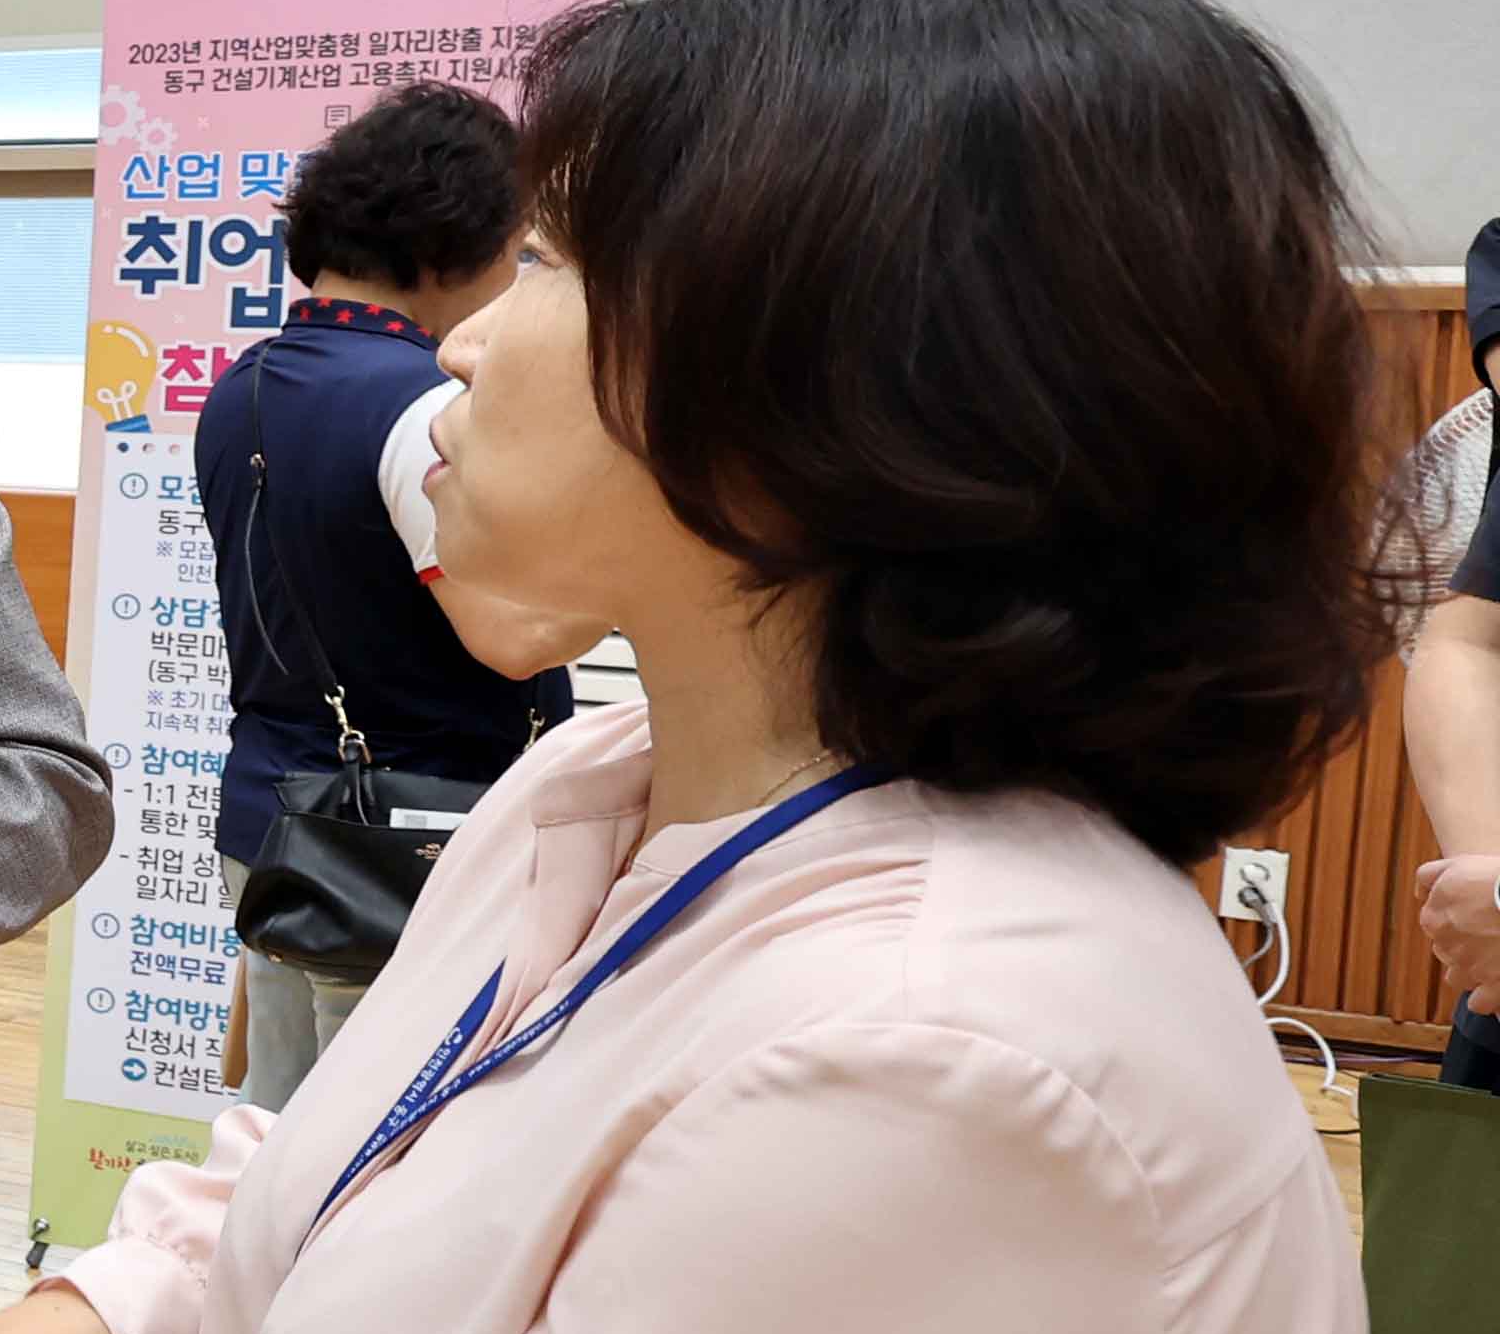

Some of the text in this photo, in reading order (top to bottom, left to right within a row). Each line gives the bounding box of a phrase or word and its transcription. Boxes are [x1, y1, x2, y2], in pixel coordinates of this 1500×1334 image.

[128, 39, 202, 66] 2023년
[207, 33, 361, 63] 지역산업맞춤형
[368, 27, 484, 57] 일자리창출
[163, 69, 206, 94] 동구
[211, 64, 342, 93] 건설기계산업
[122, 152, 303, 199] 산업 맞
[119, 215, 288, 329] 취업
[157, 509, 206, 536] 동구
[148, 659, 199, 685] (동구
[142, 781, 176, 806] 1:1
[139, 808, 189, 838] 통한
[136, 845, 185, 875] 취업
[136, 874, 208, 906] 일자리
[129, 913, 243, 959] 참여비용
[130, 950, 227, 986] 전액무료
[124, 1026, 197, 1060] 신청서
